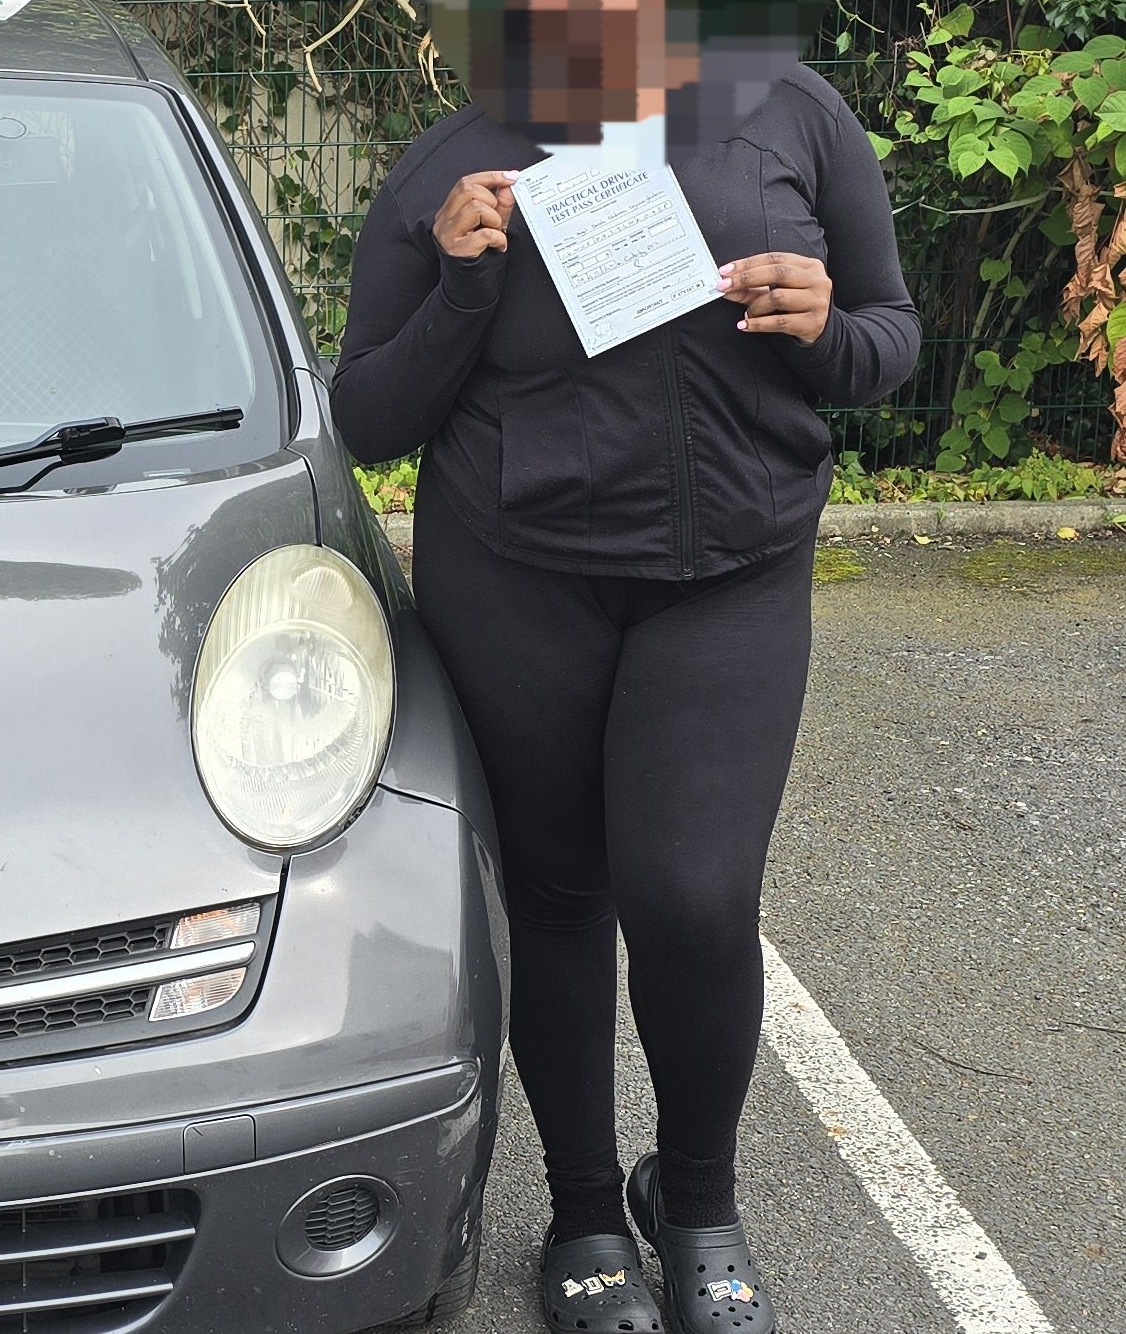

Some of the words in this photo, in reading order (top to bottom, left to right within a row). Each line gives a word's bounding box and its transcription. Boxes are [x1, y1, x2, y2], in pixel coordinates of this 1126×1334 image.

[545, 185, 600, 216] PRACTICAL
[549, 208, 572, 224] TEST
[573, 198, 594, 214] PASS
[594, 170, 649, 204] CERTIFICATE
